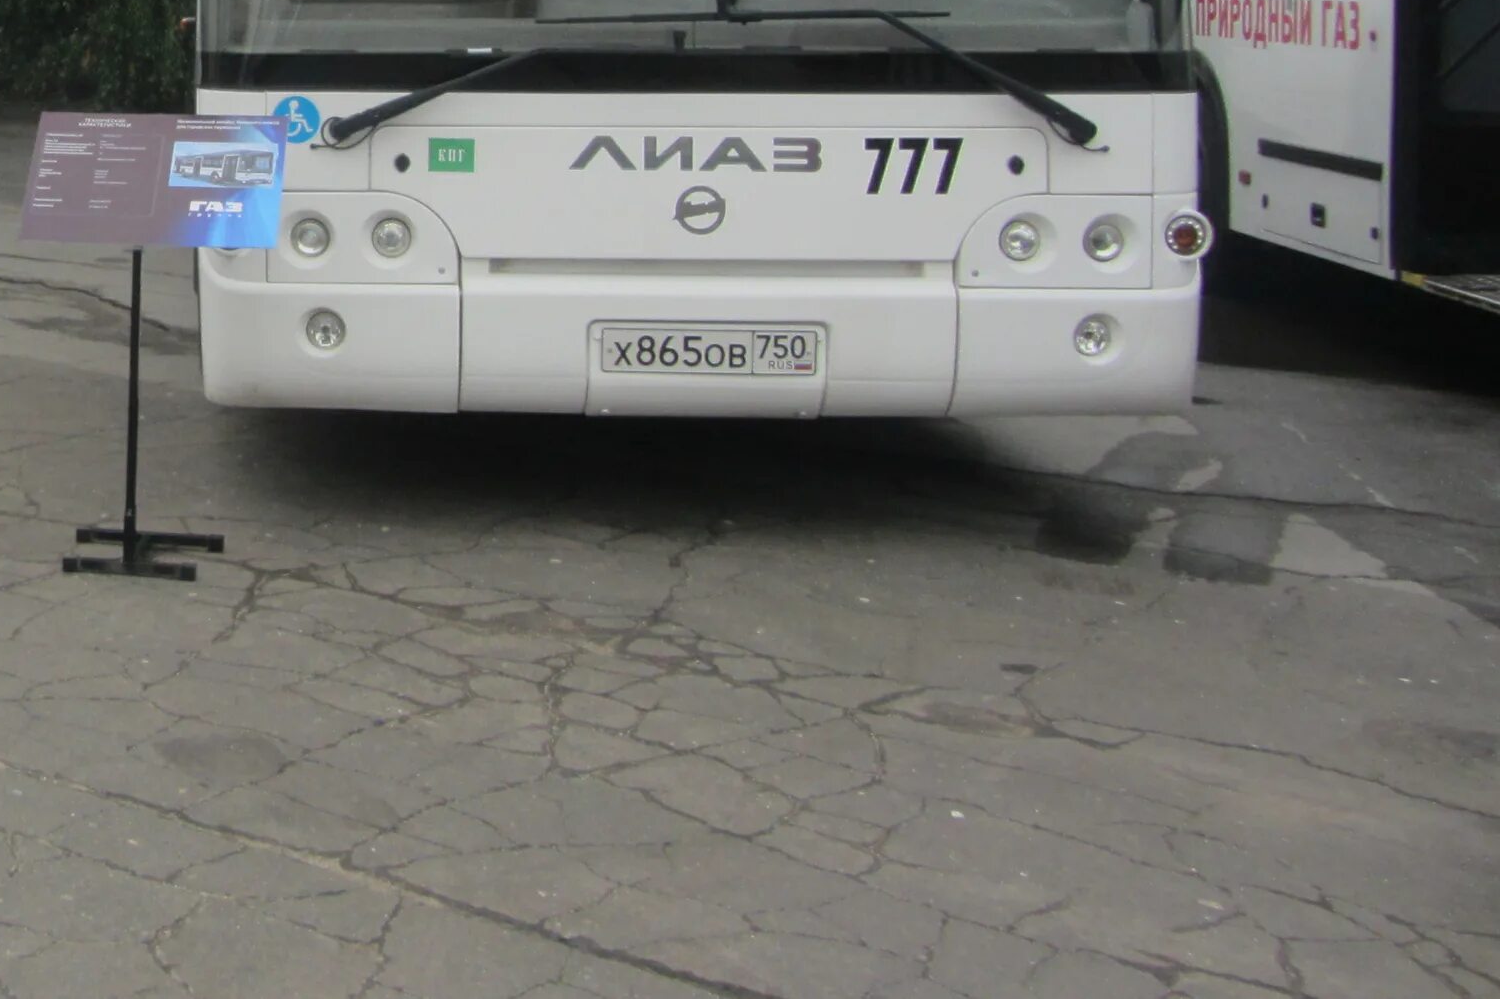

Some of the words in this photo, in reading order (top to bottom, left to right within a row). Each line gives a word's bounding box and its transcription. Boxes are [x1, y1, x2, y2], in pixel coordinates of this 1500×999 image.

[1321, 0, 1360, 51] ГАЗ
[569, 135, 822, 172] ЛИАЗ
[864, 137, 963, 195] 777
[189, 200, 243, 213] ГАЗ
[756, 334, 806, 359] 750
[768, 360, 793, 370] RUS
